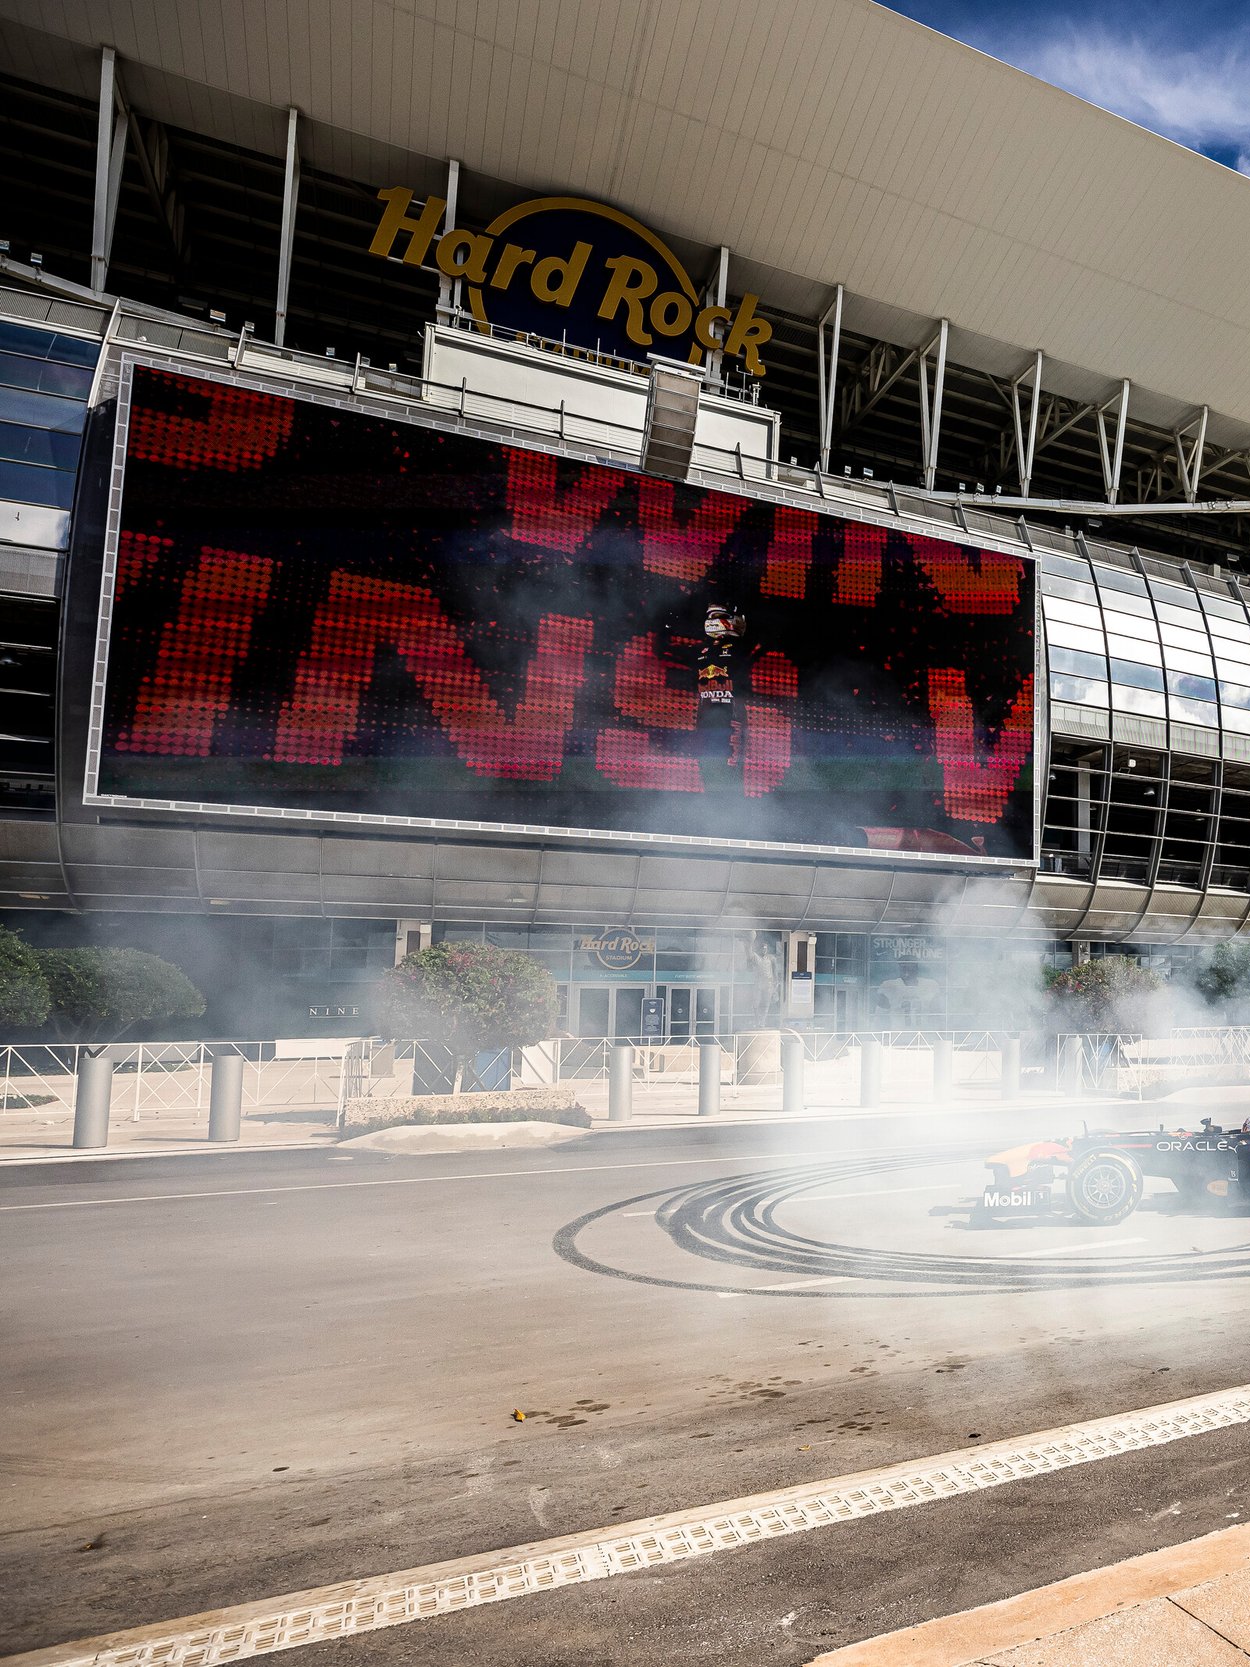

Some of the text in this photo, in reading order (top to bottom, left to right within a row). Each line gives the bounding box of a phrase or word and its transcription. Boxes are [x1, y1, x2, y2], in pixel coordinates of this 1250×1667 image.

[368, 185, 773, 376] Hard Rock
[580, 935, 655, 954] Hard Rock
[309, 1007, 359, 1016] NINE
[1156, 1140, 1228, 1152] ORACLE
[984, 1191, 1032, 1207] Mobil
